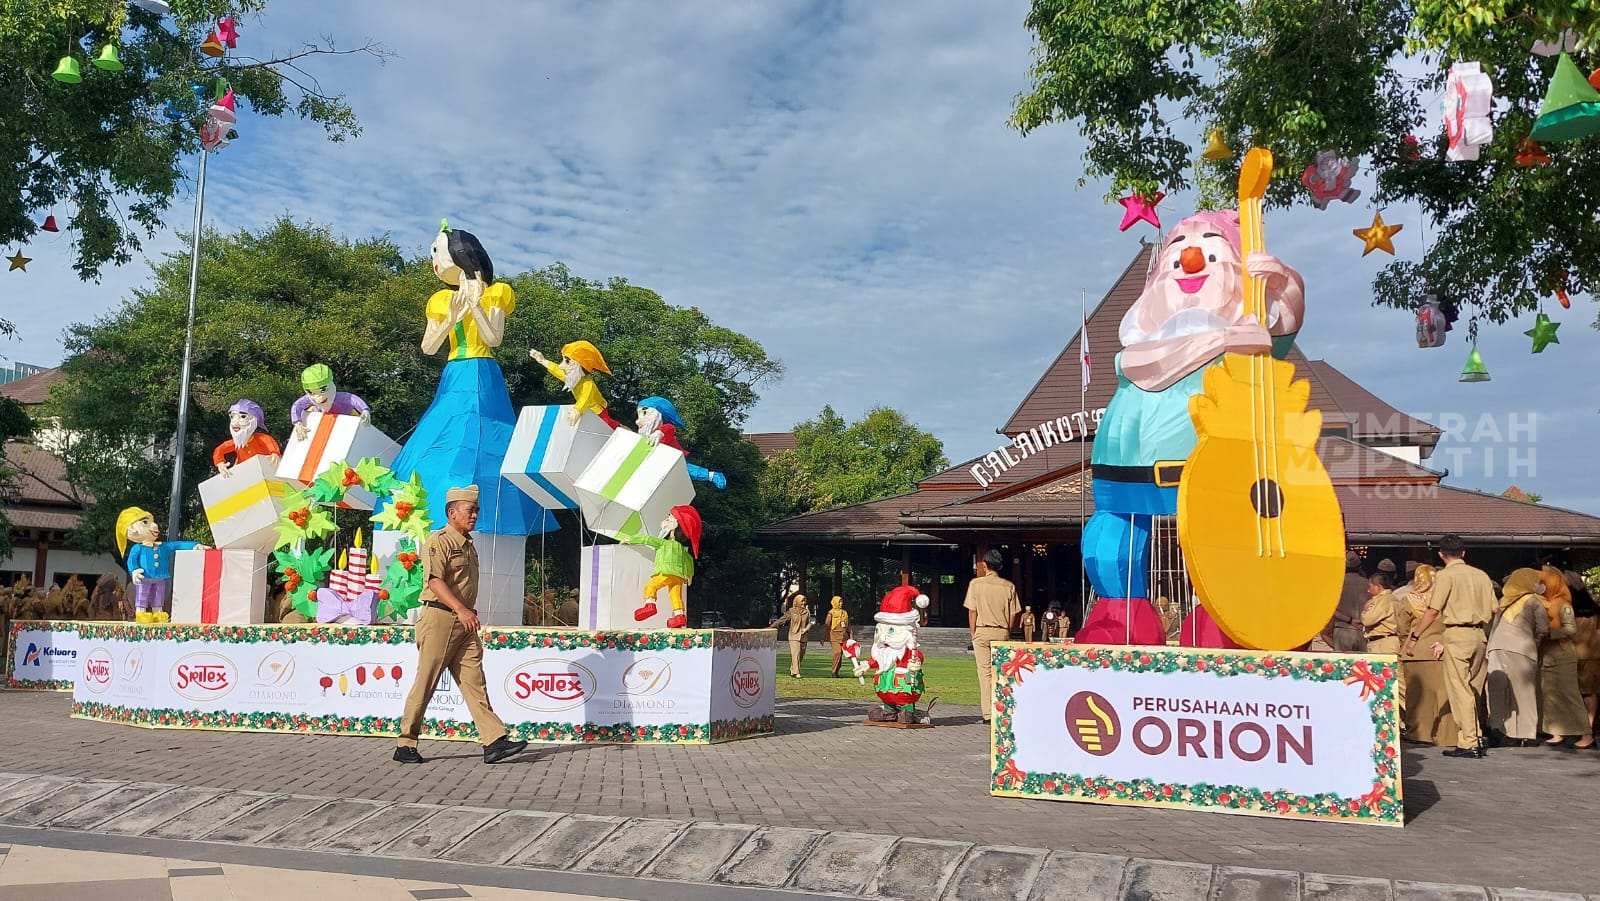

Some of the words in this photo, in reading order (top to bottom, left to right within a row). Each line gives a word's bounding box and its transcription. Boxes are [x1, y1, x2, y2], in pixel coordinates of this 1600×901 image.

[43, 646, 77, 658] Keluarg
[248, 688, 297, 701] DIAMOND
[430, 694, 465, 706] MOND
[613, 698, 675, 710] DIAMOND
[1133, 696, 1259, 717] PERUSAHAAN
[1265, 702, 1310, 720] ROTI
[1131, 715, 1315, 766] ORION
